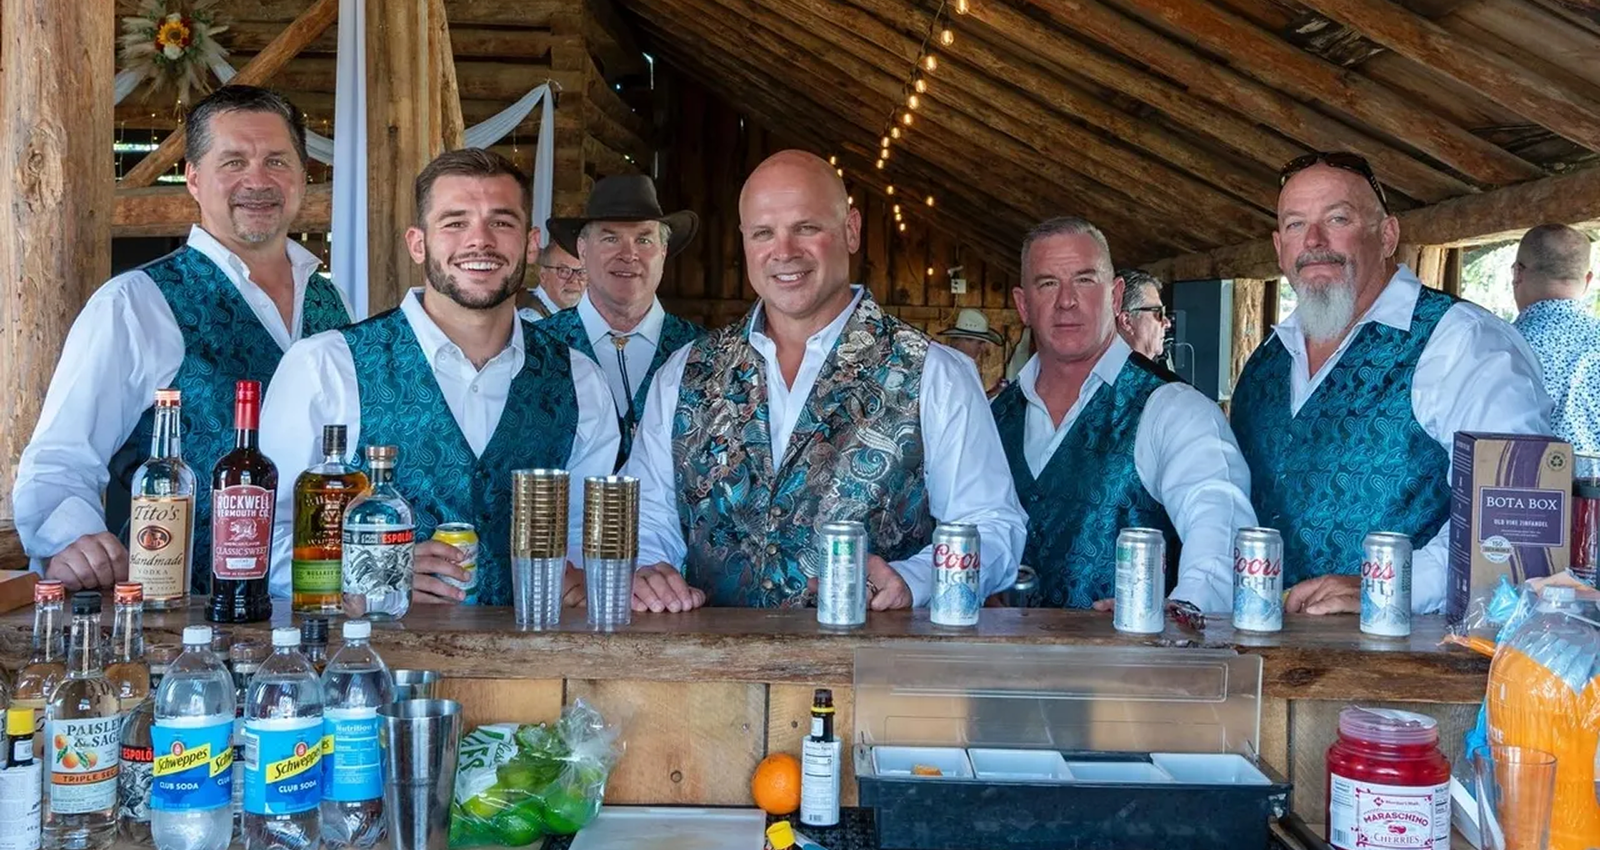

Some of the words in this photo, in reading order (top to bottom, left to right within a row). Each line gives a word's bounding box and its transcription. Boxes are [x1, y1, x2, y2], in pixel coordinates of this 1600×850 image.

[217, 495, 270, 509] ROCKWELL
[1486, 496, 1525, 509] BOTA
[1528, 498, 1558, 511] BOX
[134, 504, 180, 521] Tito's
[217, 509, 256, 518] VERMOUTH
[335, 723, 372, 733] Nutrition
[157, 748, 208, 774] Schweppes
[62, 773, 100, 783] TRIPLE
[101, 769, 116, 780] SEC
[159, 781, 175, 790] CLUB
[175, 782, 199, 791] SODA
[278, 783, 299, 793] CLUB
[299, 780, 318, 791] SODA
[1363, 811, 1429, 828] MARASCHINO
[1373, 832, 1420, 845] CHERRIES
